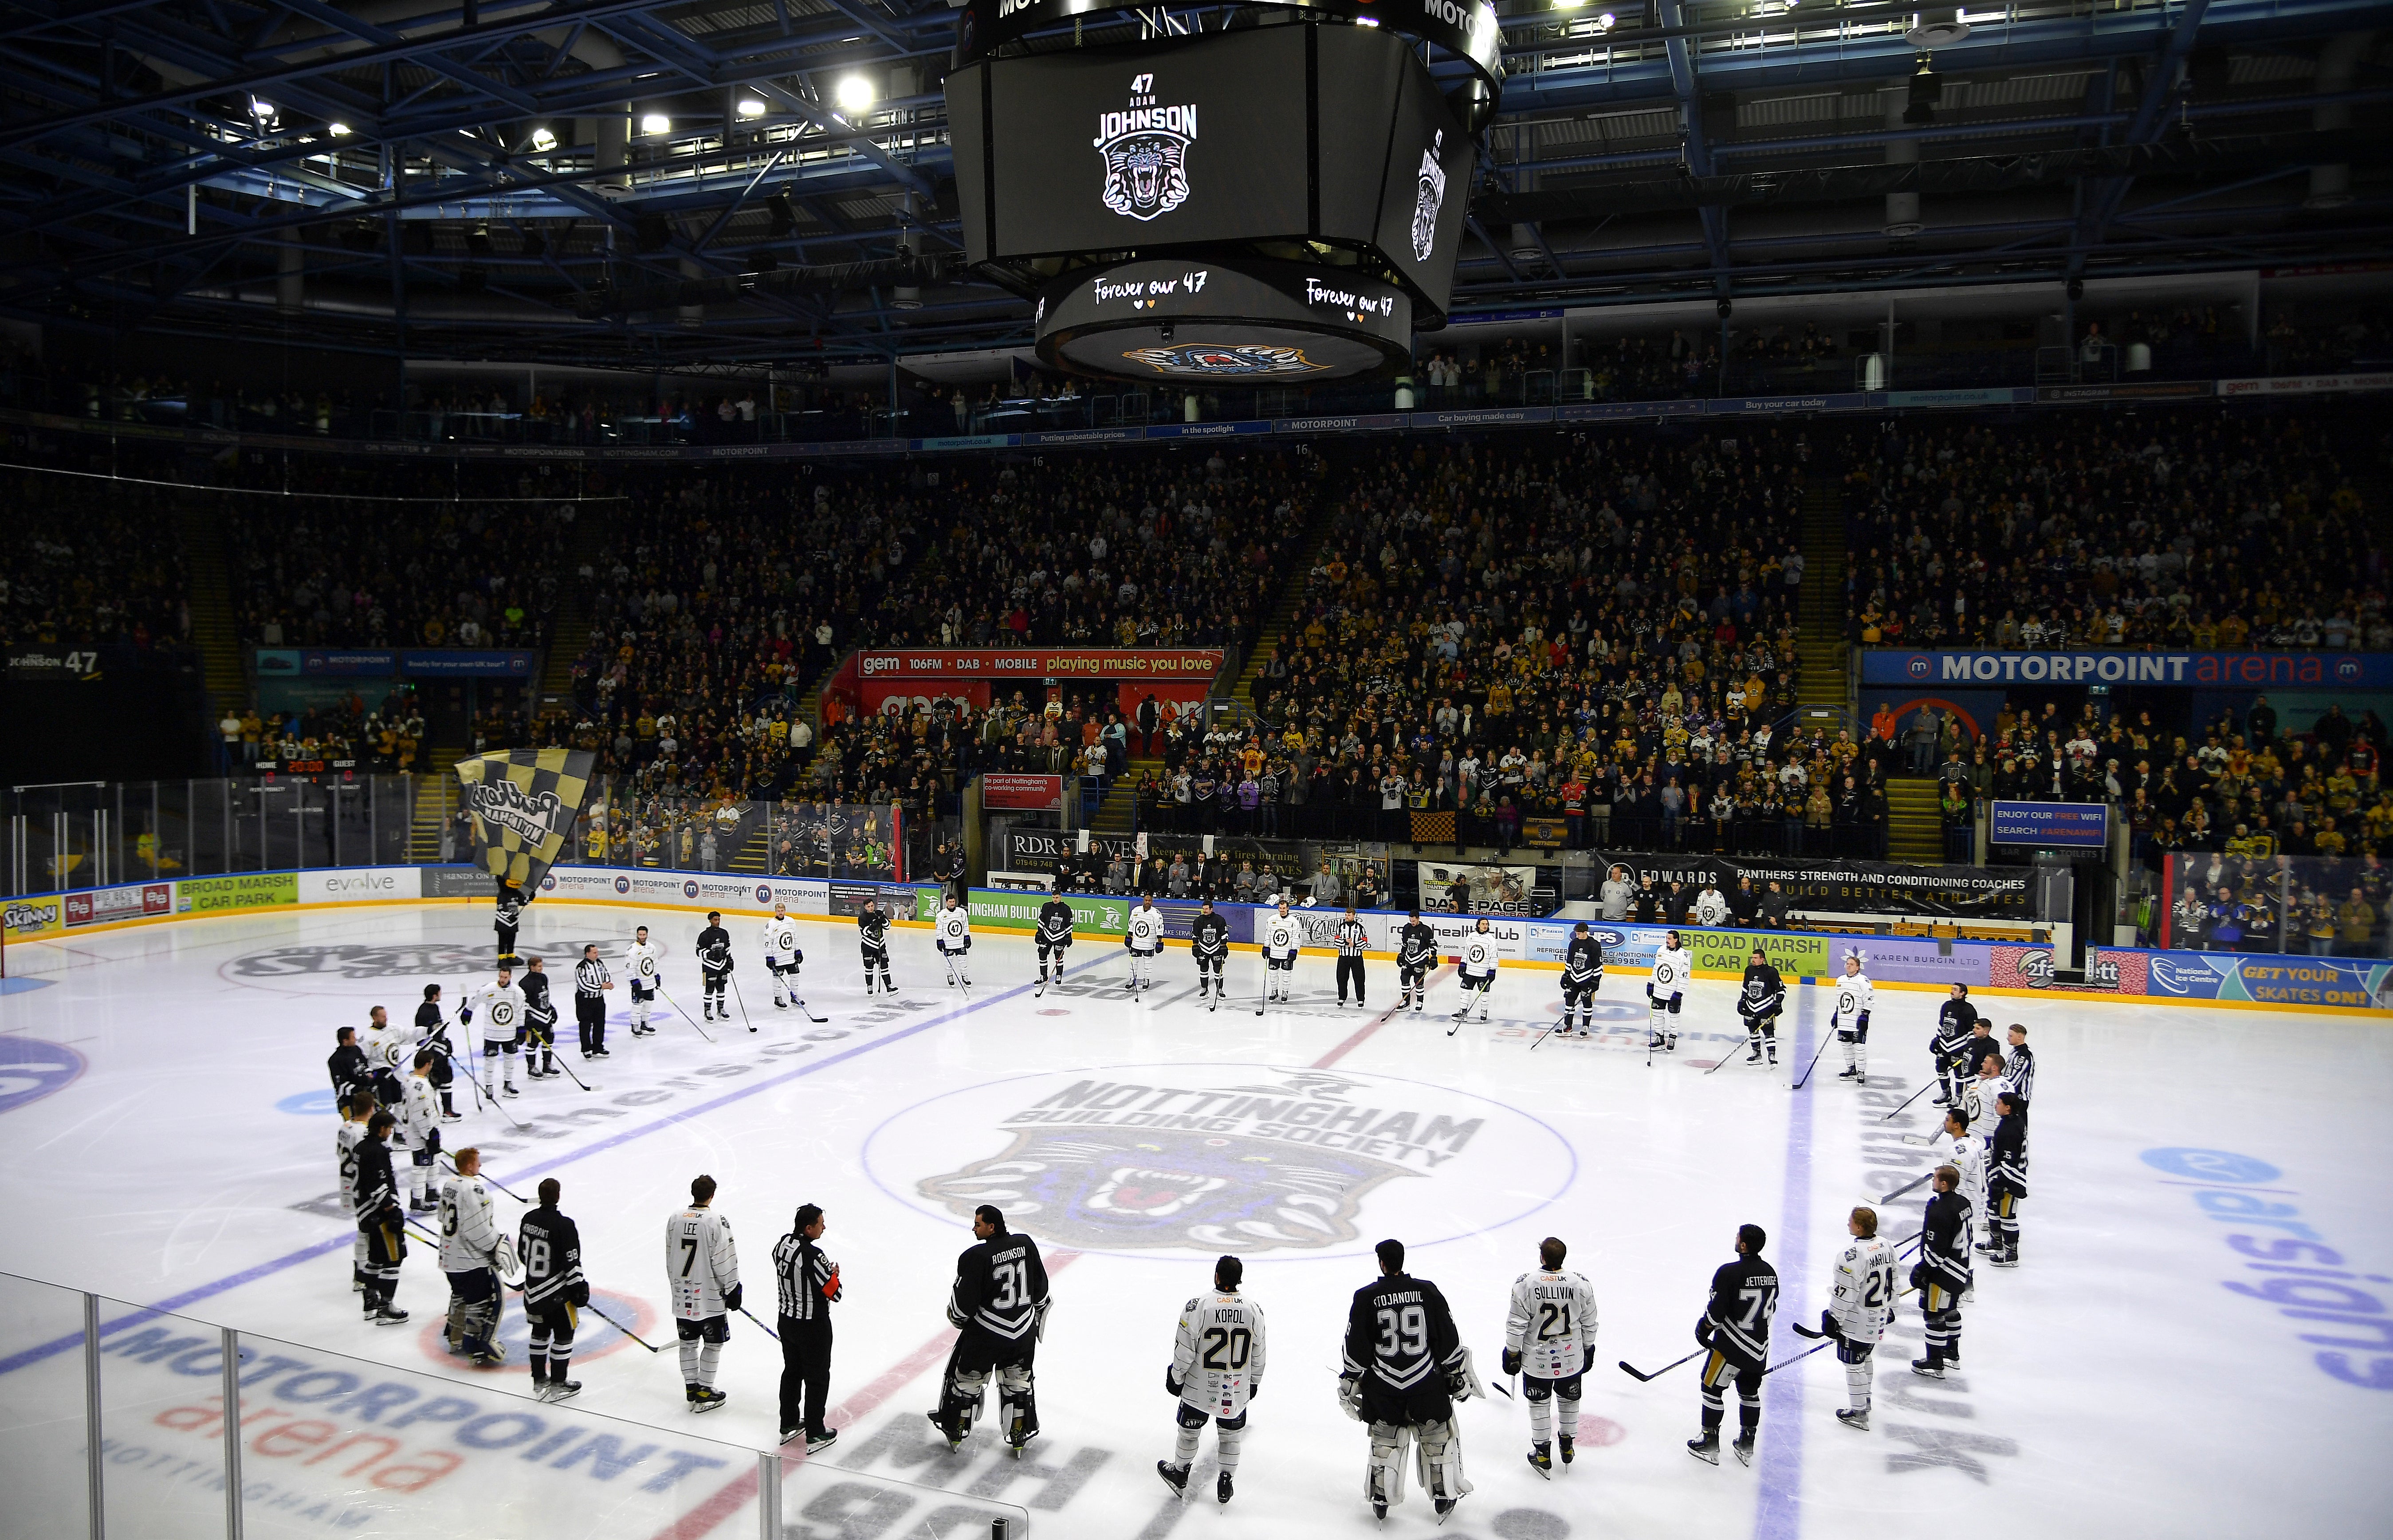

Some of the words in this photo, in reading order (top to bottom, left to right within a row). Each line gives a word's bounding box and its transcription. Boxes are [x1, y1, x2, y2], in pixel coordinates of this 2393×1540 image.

[1131, 73, 1153, 93] 47
[1129, 95, 1156, 107] ADAM
[1093, 103, 1197, 147] JOHNSON
[1418, 147, 1446, 200] JOHNSON
[1094, 278, 1143, 304] Forever
[1148, 281, 1178, 296] our
[1183, 271, 1208, 294] 47
[1306, 278, 1356, 308] Forever
[1359, 290, 1378, 313] our
[1379, 295, 1394, 318] 47
[1801, 399, 1826, 408] today
[1202, 426, 1234, 434] spotlight
[1291, 419, 1357, 429] MOTORPOINT
[1295, 444, 1308, 455] 16
[1032, 457, 1044, 467] 16
[65, 651, 98, 673] 47
[863, 656, 900, 675] gem
[909, 658, 942, 670] 106FM
[956, 658, 980, 670] DAB
[995, 658, 1037, 670] MOBILE
[1047, 656, 1100, 674] playing
[1104, 657, 1147, 671] music
[1150, 659, 1179, 673] you
[1181, 656, 1213, 671] love
[1942, 656, 2189, 682] MOTORPOINT
[2196, 656, 2323, 682] arena
[1012, 777, 1048, 786] Nottingham's
[1997, 810, 2029, 819] ENJOY
[2031, 811, 2052, 820] OUR
[2080, 813, 2102, 821] WIFI
[1996, 826, 2038, 835] SEARCH
[1014, 835, 1059, 855] RDR
[1016, 859, 1038, 867] 01949
[1151, 847, 1176, 858] Keep
[1234, 849, 1257, 860] fires
[1259, 850, 1299, 864] burning
[326, 872, 394, 892] evolve
[560, 876, 612, 884] MOTORPOINT
[633, 880, 681, 889] MOTORPOINT
[1641, 870, 1717, 884] EDWARDS
[1800, 870, 1858, 883] STRENGTH
[1860, 873, 1885, 884] AND
[1887, 875, 1969, 888] CONDITIONING
[1971, 879, 2026, 889] COACHES
[181, 880, 234, 895] BROAD
[238, 876, 294, 889] MARSH
[702, 884, 752, 894] MOTORPOINT
[774, 888, 827, 899] MOTORPOINT
[200, 894, 231, 909] CAR
[235, 892, 275, 907] PARK
[775, 896, 799, 904] arena
[1841, 887, 1913, 900] BETTER
[1926, 890, 2025, 904] ATHLETES
[1477, 900, 1529, 913] PAGE
[4, 905, 58, 929] SKINNY
[1136, 926, 1145, 934] 47
[1275, 933, 1285, 943] 47
[782, 936, 791, 946] 47
[1681, 933, 1746, 951] BROAD
[1753, 937, 1821, 955] MARSH
[1471, 949, 1481, 959] 47
[1701, 954, 1740, 970] CAR
[1873, 954, 1910, 962] KAREN
[1914, 956, 1955, 965] BURGIN
[1659, 969, 1669, 979] 47
[2175, 967, 2212, 978] National
[2189, 976, 2218, 985] Centre
[2243, 966, 2284, 980] GET
[2287, 967, 2339, 983] YOUR
[2255, 986, 2320, 1002] SKATES
[2325, 989, 2367, 1006] ON!
[497, 1008, 509, 1019] 47
[1028, 1078, 1486, 1155] NOTTINGHAM
[1002, 1109, 1237, 1135] BUILDING
[1248, 1118, 1460, 1170] SOCIETY
[684, 1222, 698, 1235] LEE
[566, 1248, 578, 1262] 98
[680, 1237, 699, 1278] 7
[992, 1245, 1026, 1266] ROBINSON
[777, 1259, 789, 1277] 47
[992, 1259, 1031, 1310] 31
[1832, 1285, 1845, 1297] 47
[1862, 1267, 1891, 1307] 24
[1216, 1296, 1244, 1304] CASTUK
[1534, 1286, 1575, 1301] SULLIVAN
[1214, 1308, 1245, 1325] KOROL
[1737, 1288, 1776, 1330] 74
[1537, 1302, 1572, 1342] 21
[1374, 1305, 1427, 1358] 39
[1202, 1327, 1253, 1373] 20
[102, 1326, 728, 1493] MOTORPOINT
[152, 1396, 465, 1494] arena
